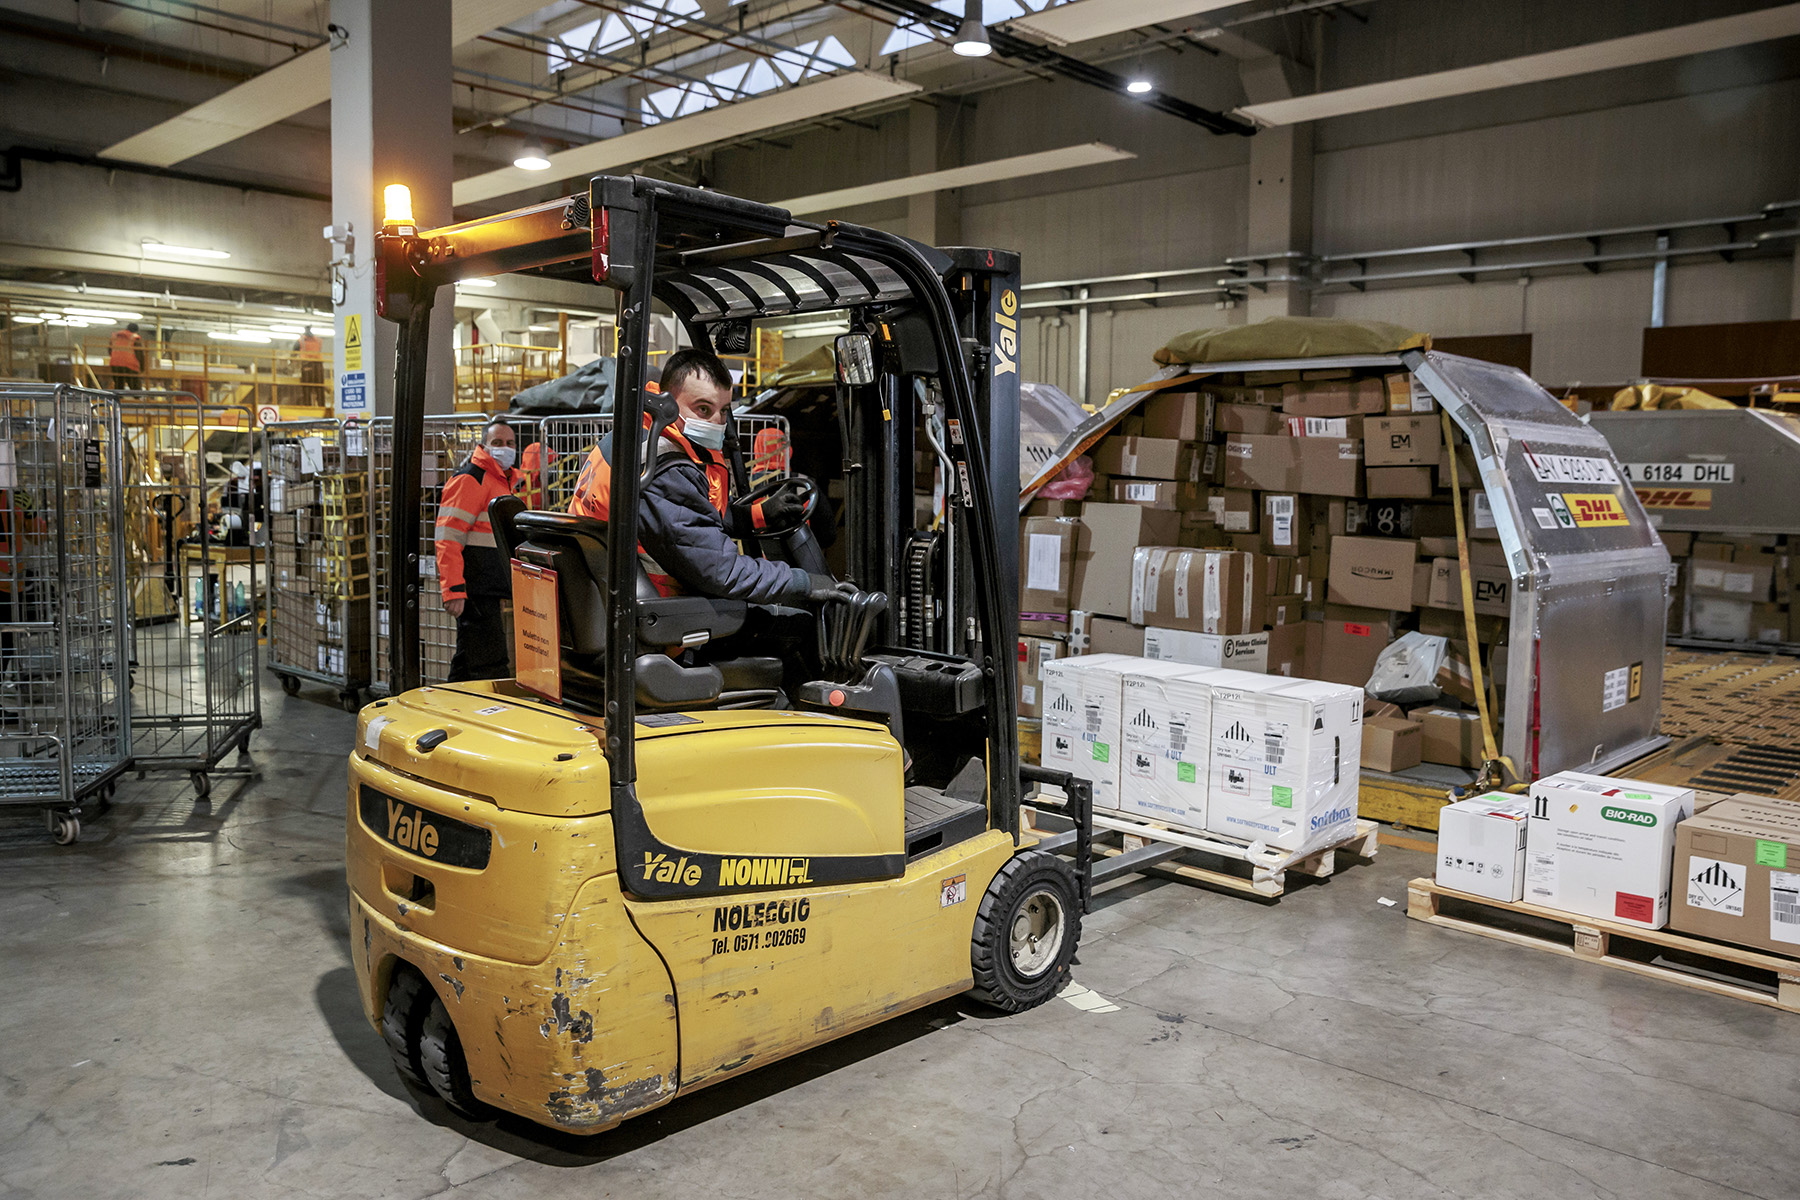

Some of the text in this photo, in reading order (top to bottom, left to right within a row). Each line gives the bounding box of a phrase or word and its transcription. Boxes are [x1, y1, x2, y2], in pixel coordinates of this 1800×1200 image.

[995, 289, 1017, 376] Yale
[1391, 434, 1410, 448] EM
[1644, 465, 1682, 480] 6184
[1694, 466, 1731, 481] DHL
[1575, 500, 1619, 521] DHL
[1475, 580, 1506, 603] EM
[1170, 750, 1182, 760] ULT
[1264, 764, 1277, 776] ULT
[1310, 807, 1351, 830] Softbox
[1605, 809, 1653, 824] BIO-RAD
[386, 798, 439, 856] Yale
[1710, 824, 1790, 840] COVANCE
[643, 851, 702, 886] Yale
[712, 938, 729, 955] Tel.
